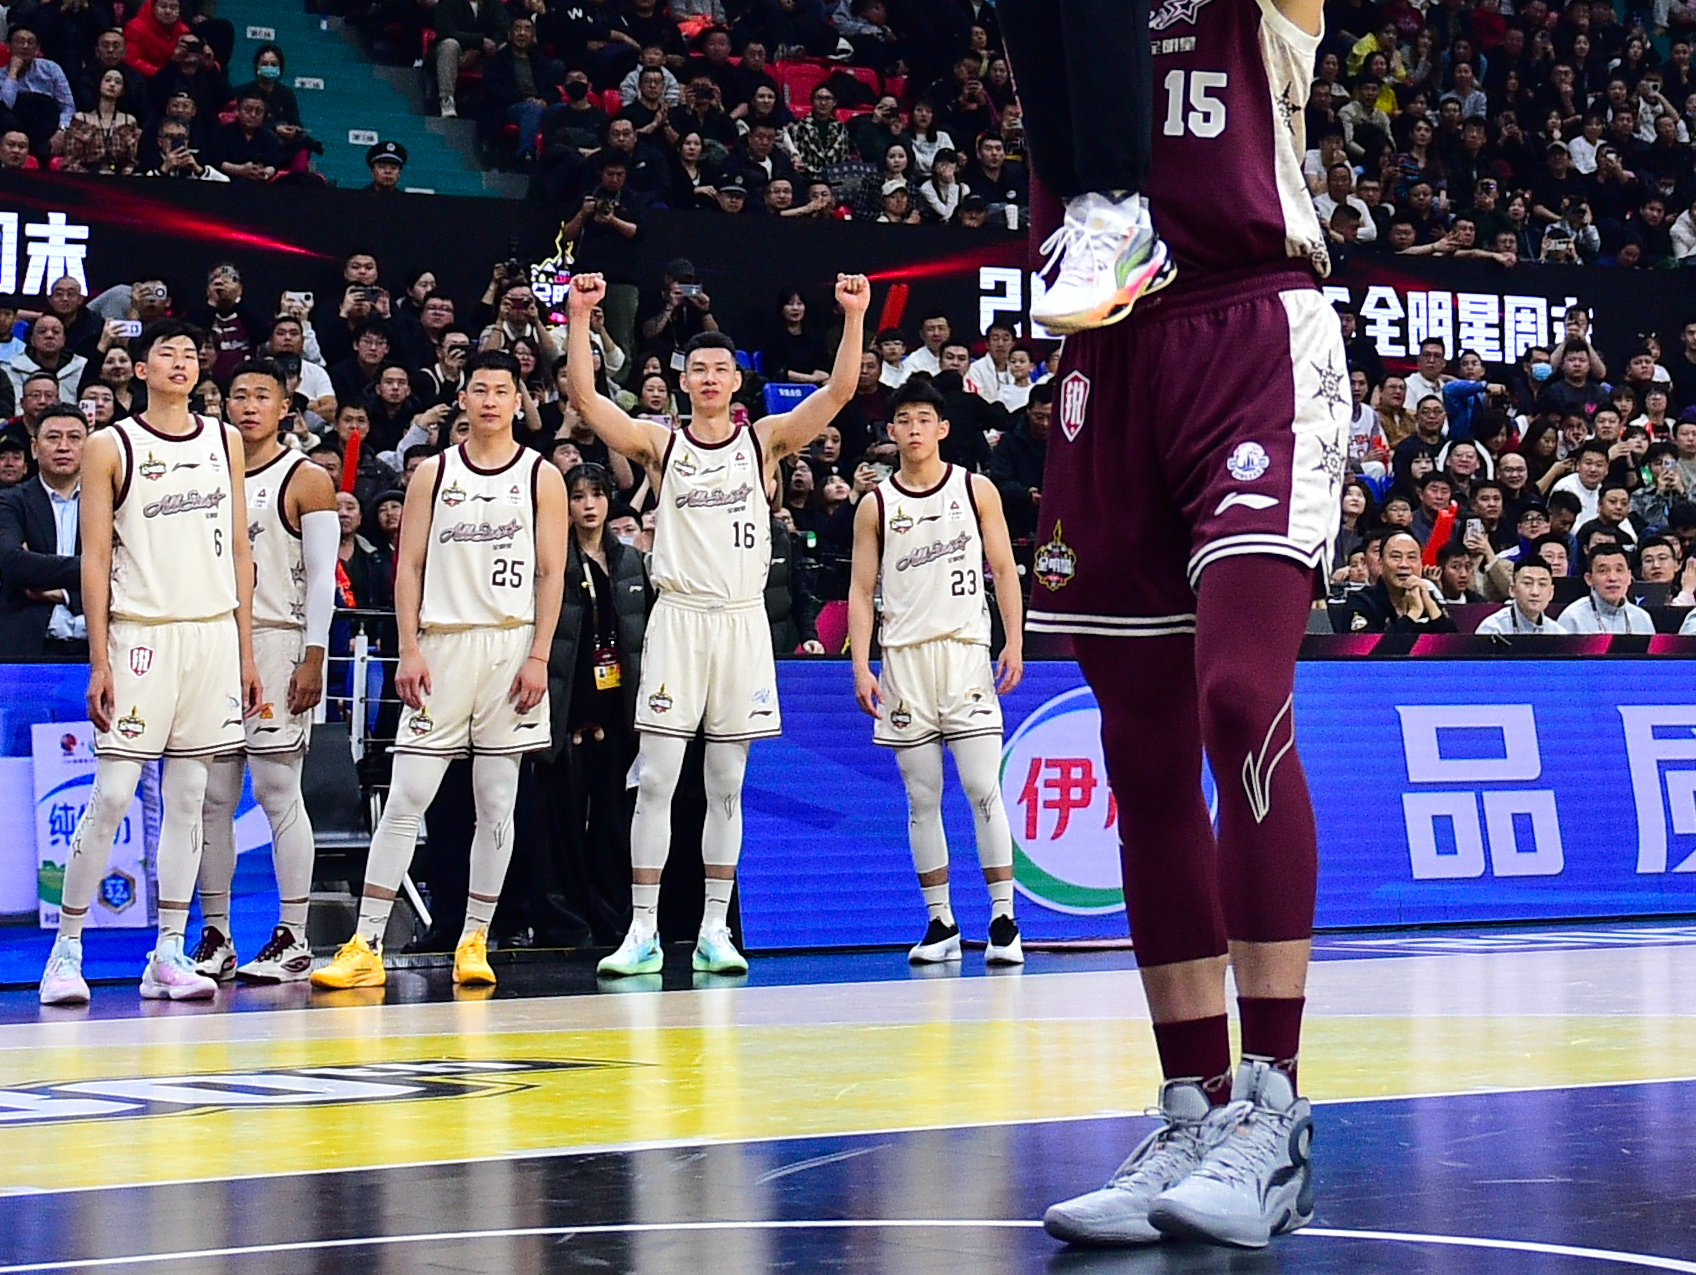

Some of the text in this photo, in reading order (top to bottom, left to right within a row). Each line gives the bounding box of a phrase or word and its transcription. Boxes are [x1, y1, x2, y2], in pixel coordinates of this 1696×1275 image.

[1163, 69, 1227, 138] 15
[213, 528, 222, 557] 6
[732, 521, 756, 549] 16
[491, 558, 525, 588] 25
[950, 569, 977, 596] 23
[1017, 757, 1118, 841] 伊
